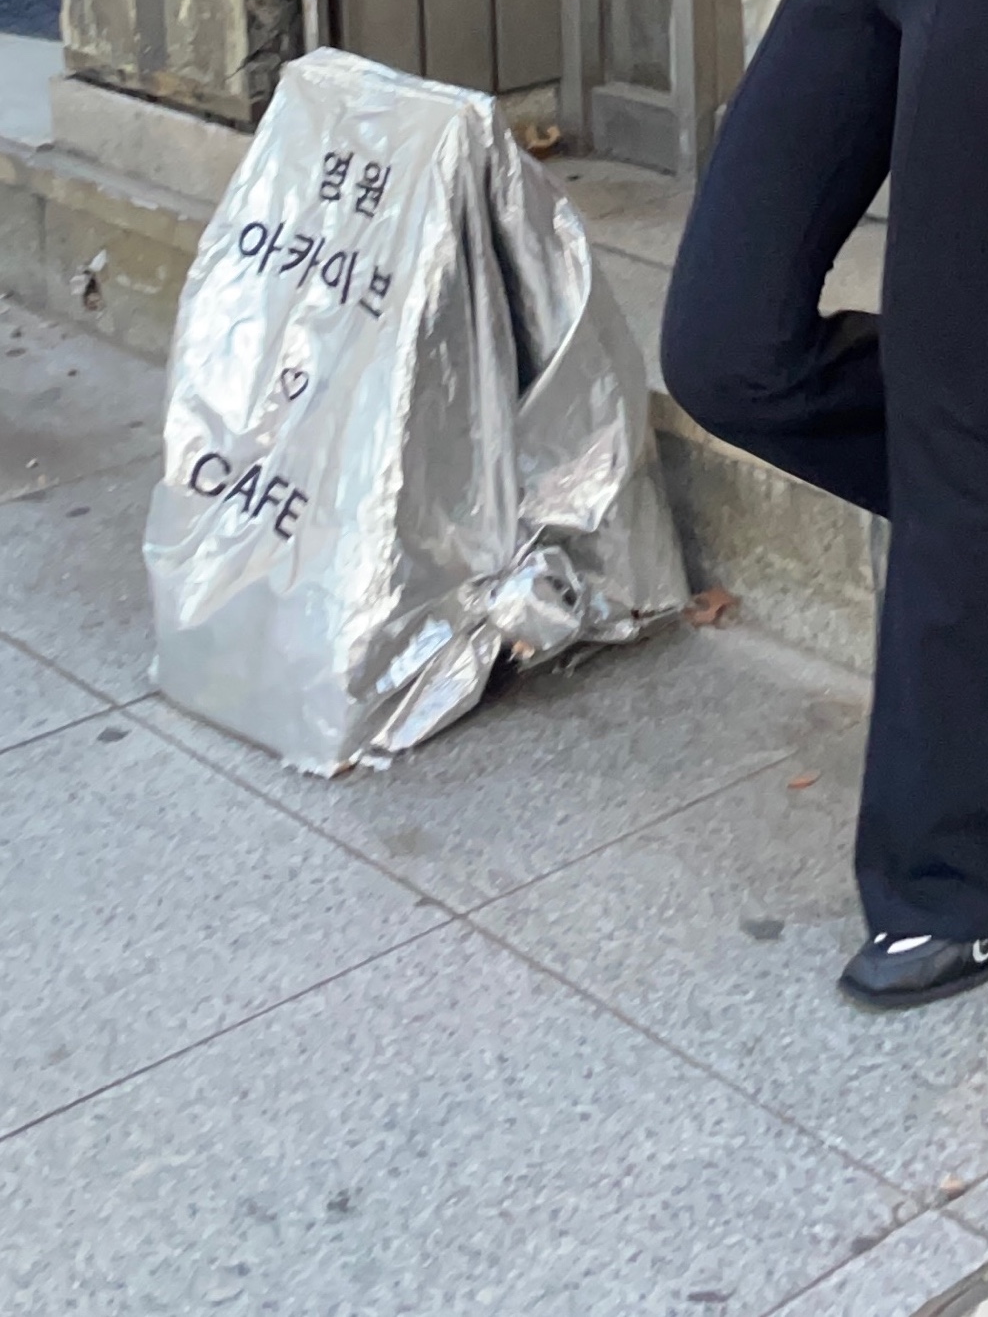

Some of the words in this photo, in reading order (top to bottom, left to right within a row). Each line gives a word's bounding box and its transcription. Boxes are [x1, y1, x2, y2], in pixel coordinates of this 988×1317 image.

[320, 151, 391, 217] 영원
[238, 221, 391, 319] 아카이브
[189, 452, 308, 540] CAFE
